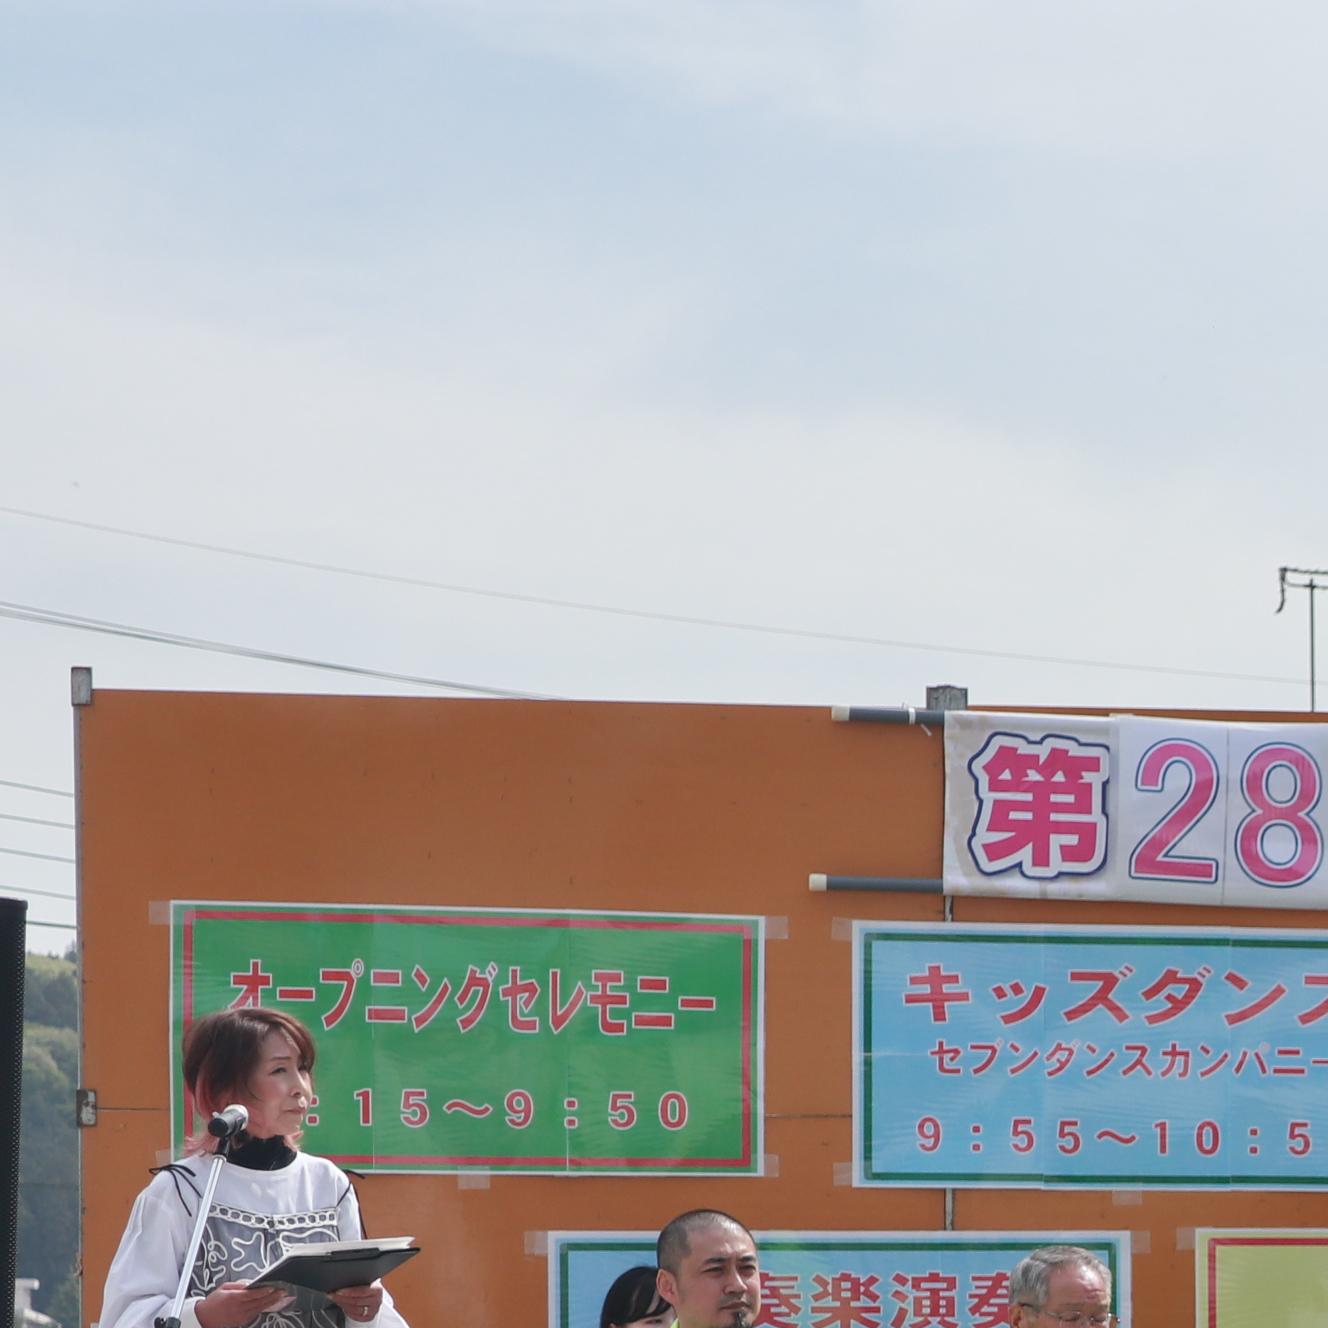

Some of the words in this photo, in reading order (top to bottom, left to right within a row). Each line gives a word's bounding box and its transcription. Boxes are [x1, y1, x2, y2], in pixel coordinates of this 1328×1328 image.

[228, 958, 717, 1037] オープニングセレモニー
[306, 1087, 690, 1131] :15～9:50
